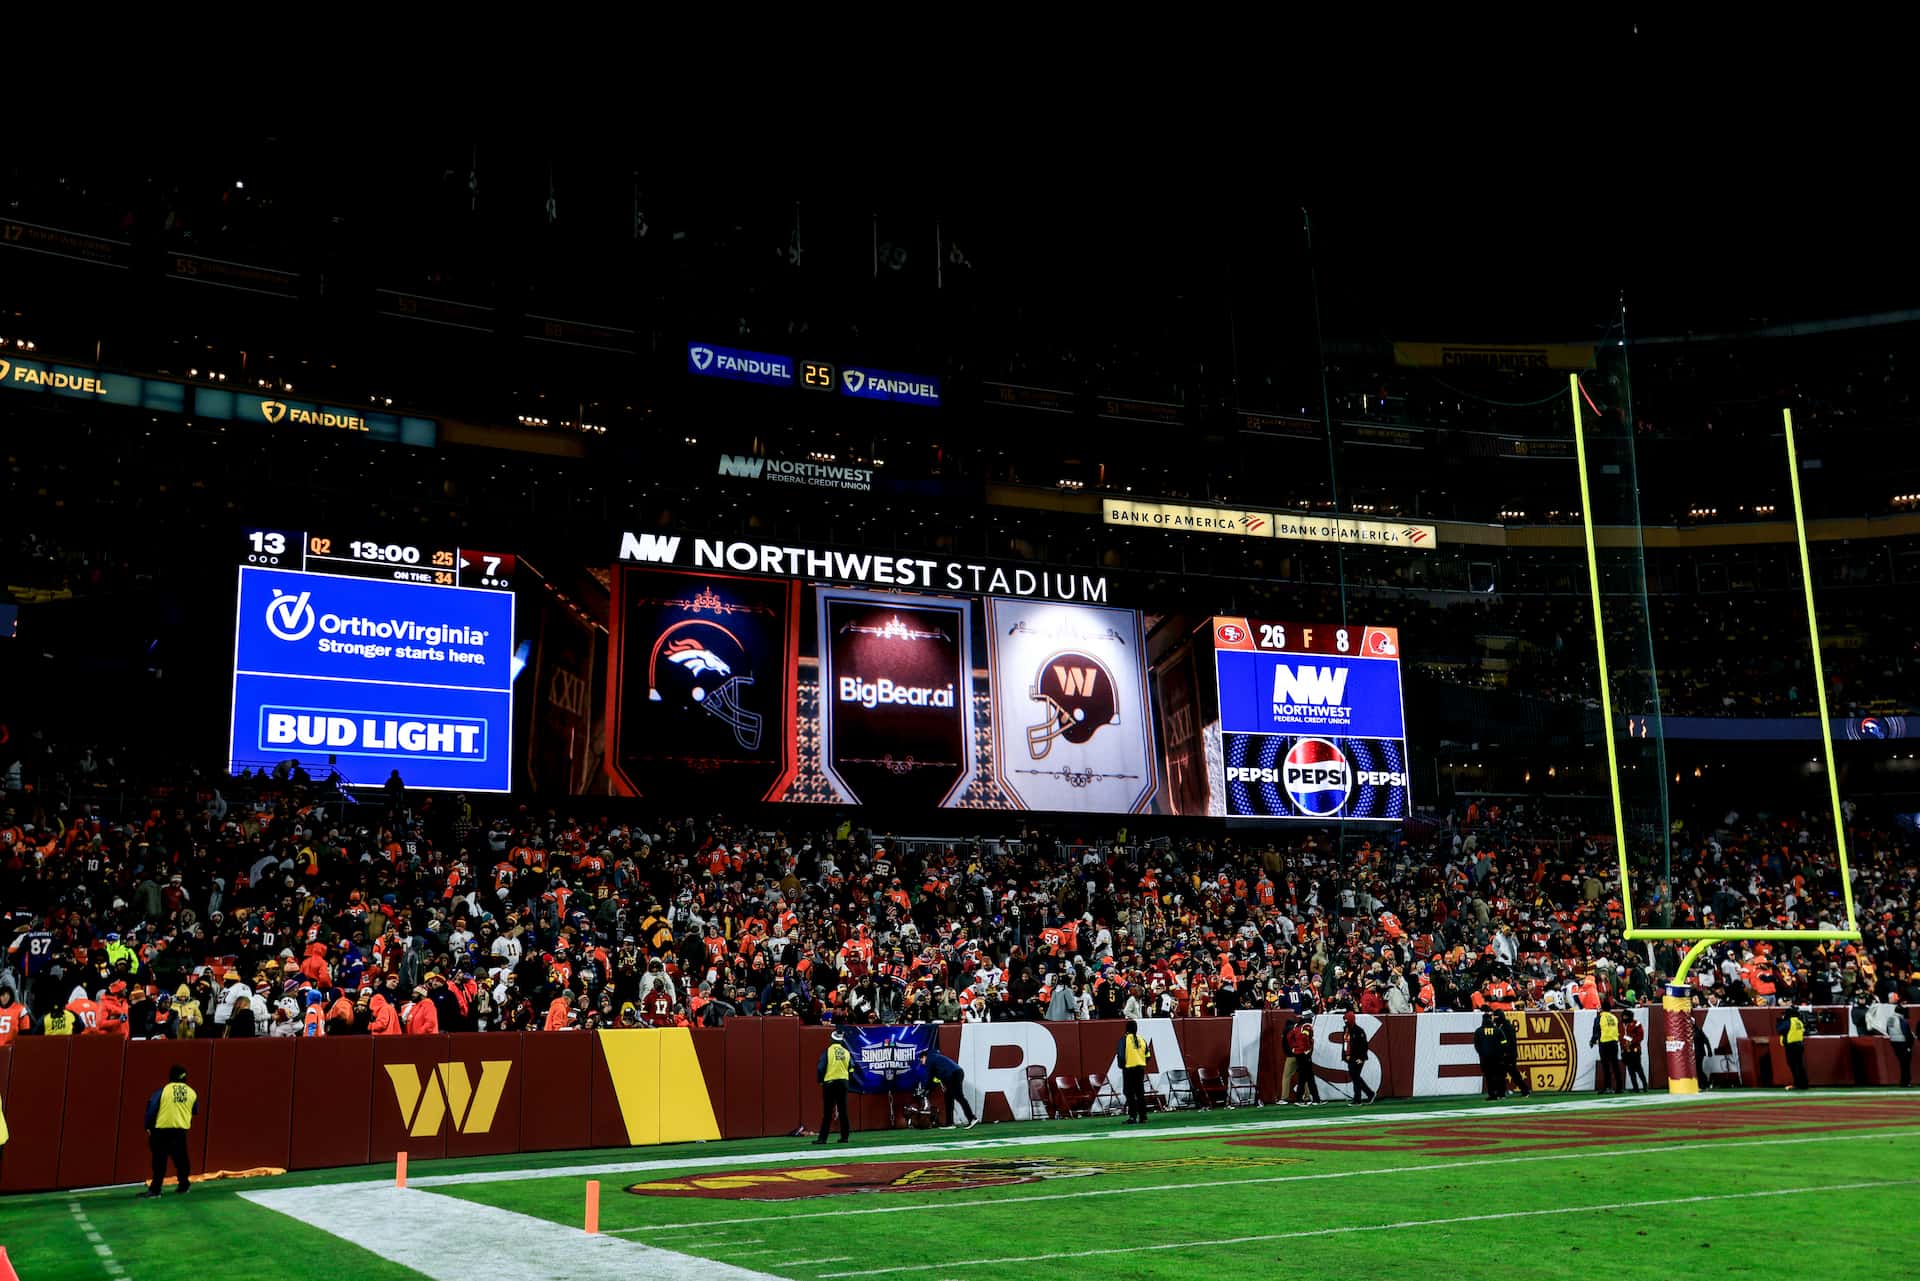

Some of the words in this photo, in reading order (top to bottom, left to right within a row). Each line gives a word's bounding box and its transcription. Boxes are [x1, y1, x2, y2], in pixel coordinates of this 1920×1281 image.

[717, 355, 791, 378] FANDUEL
[14, 366, 107, 394] FANDUEL
[806, 365, 830, 386] 25
[868, 377, 939, 398] FANDUEL
[289, 408, 369, 432] FANDUEL
[718, 454, 764, 479] NW
[766, 459, 873, 483] NORTHWEST
[767, 474, 806, 485] FEDERAL
[808, 478, 838, 488] CREDIT
[840, 482, 871, 491] UNION
[1112, 510, 1149, 523] BANK
[1153, 514, 1171, 524] OF
[1174, 515, 1235, 529] AMERICA
[1281, 524, 1317, 537] BANK
[1321, 527, 1337, 537] OF
[1341, 528, 1399, 542] AMERICA
[249, 532, 286, 554] 13
[311, 537, 330, 554] Q2
[350, 541, 420, 563] 13:00
[432, 551, 453, 566] :25
[483, 556, 501, 576] 7
[619, 532, 681, 563] NW
[695, 538, 936, 586] NORTHWEST
[946, 563, 1107, 602] STADIUM
[394, 571, 409, 580] ON
[435, 571, 452, 585] 34
[1259, 624, 1285, 648] 26
[1303, 628, 1313, 648] F
[1336, 629, 1349, 651] 8
[318, 638, 391, 658] Stronger
[395, 648, 444, 661] starts
[839, 677, 954, 708] BigBear.ai
[1273, 664, 1348, 705] NW
[1272, 704, 1352, 718] NORTHWEST
[267, 713, 357, 747] BUD
[1227, 767, 1278, 783] PEPSI
[1288, 768, 1347, 785] PEPSI
[1357, 771, 1406, 786] PEPSI
[88, 859, 99, 871] 10
[875, 864, 890, 876] 92
[31, 938, 51, 955] 87
[263, 932, 274, 946] 10
[1045, 933, 1059, 945] 58
[508, 944, 517, 957] 11
[988, 974, 995, 985] 7
[656, 1001, 668, 1014] 17
[862, 1049, 892, 1062] SUNDAY
[894, 1047, 916, 1061] NIGHT
[869, 1060, 909, 1069] FOOTBALL
[1537, 1074, 1554, 1088] 32
